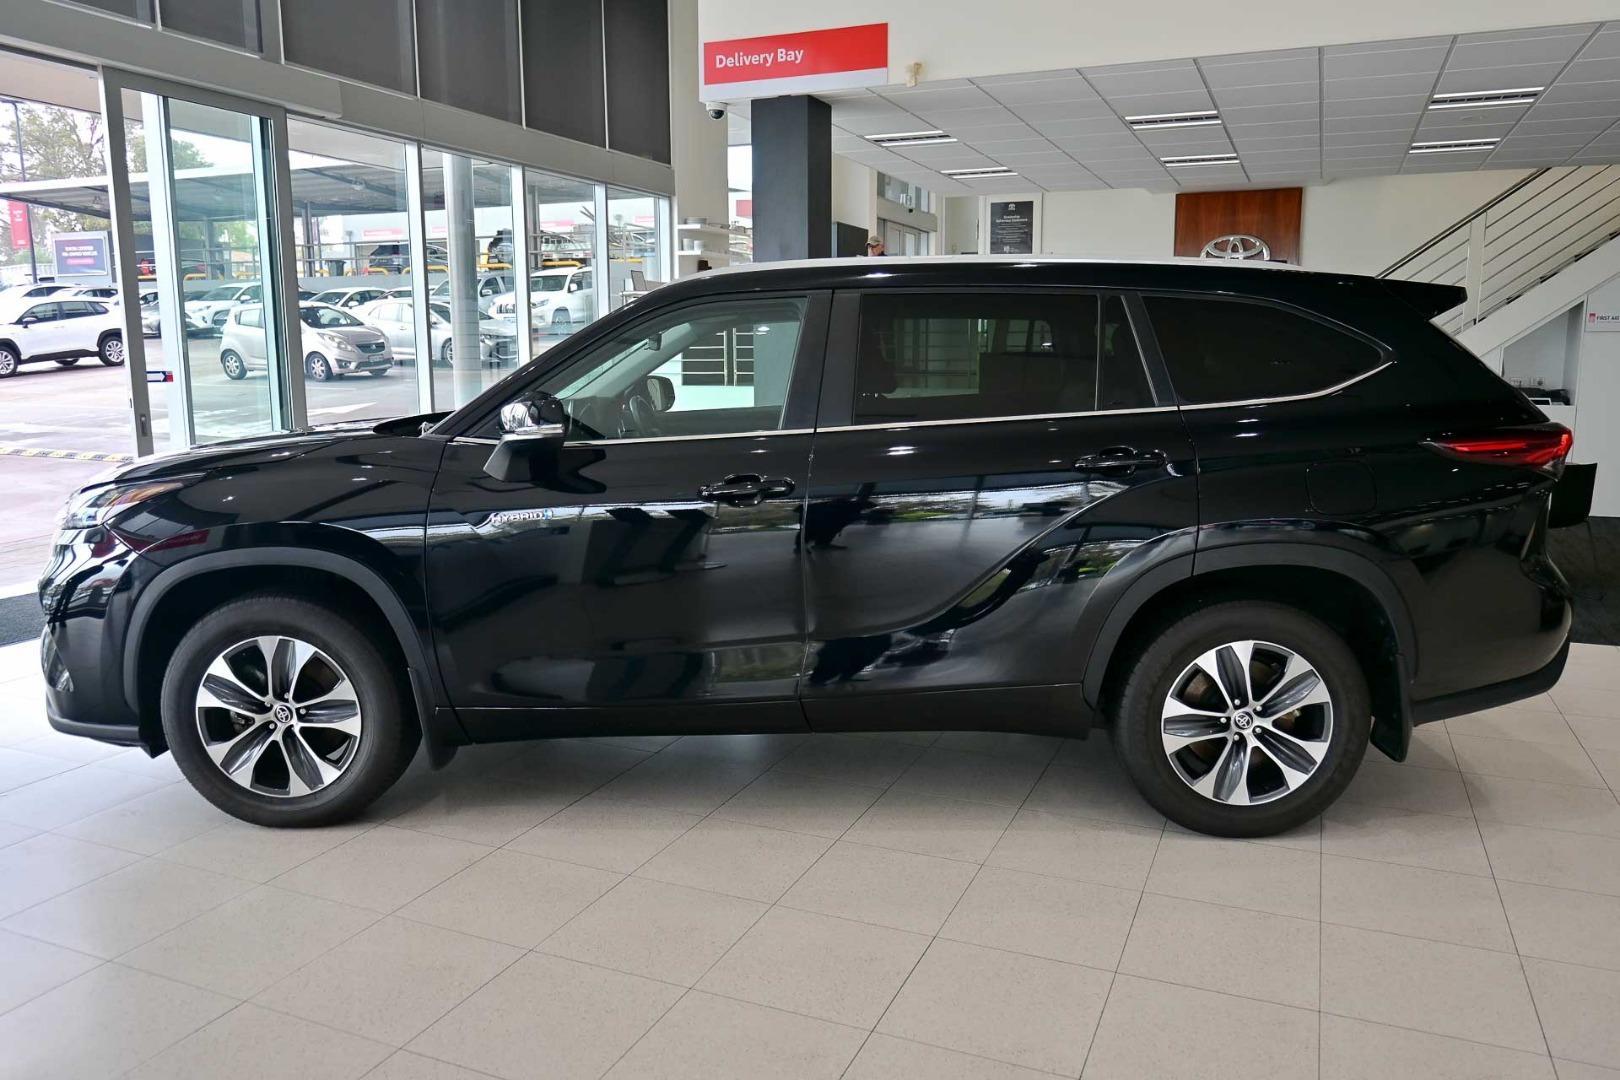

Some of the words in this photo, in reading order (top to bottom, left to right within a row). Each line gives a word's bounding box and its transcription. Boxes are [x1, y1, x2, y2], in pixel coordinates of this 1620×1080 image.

[715, 52, 774, 68] Delivery
[777, 48, 804, 64] Bay
[490, 511, 543, 523] HYBRID
